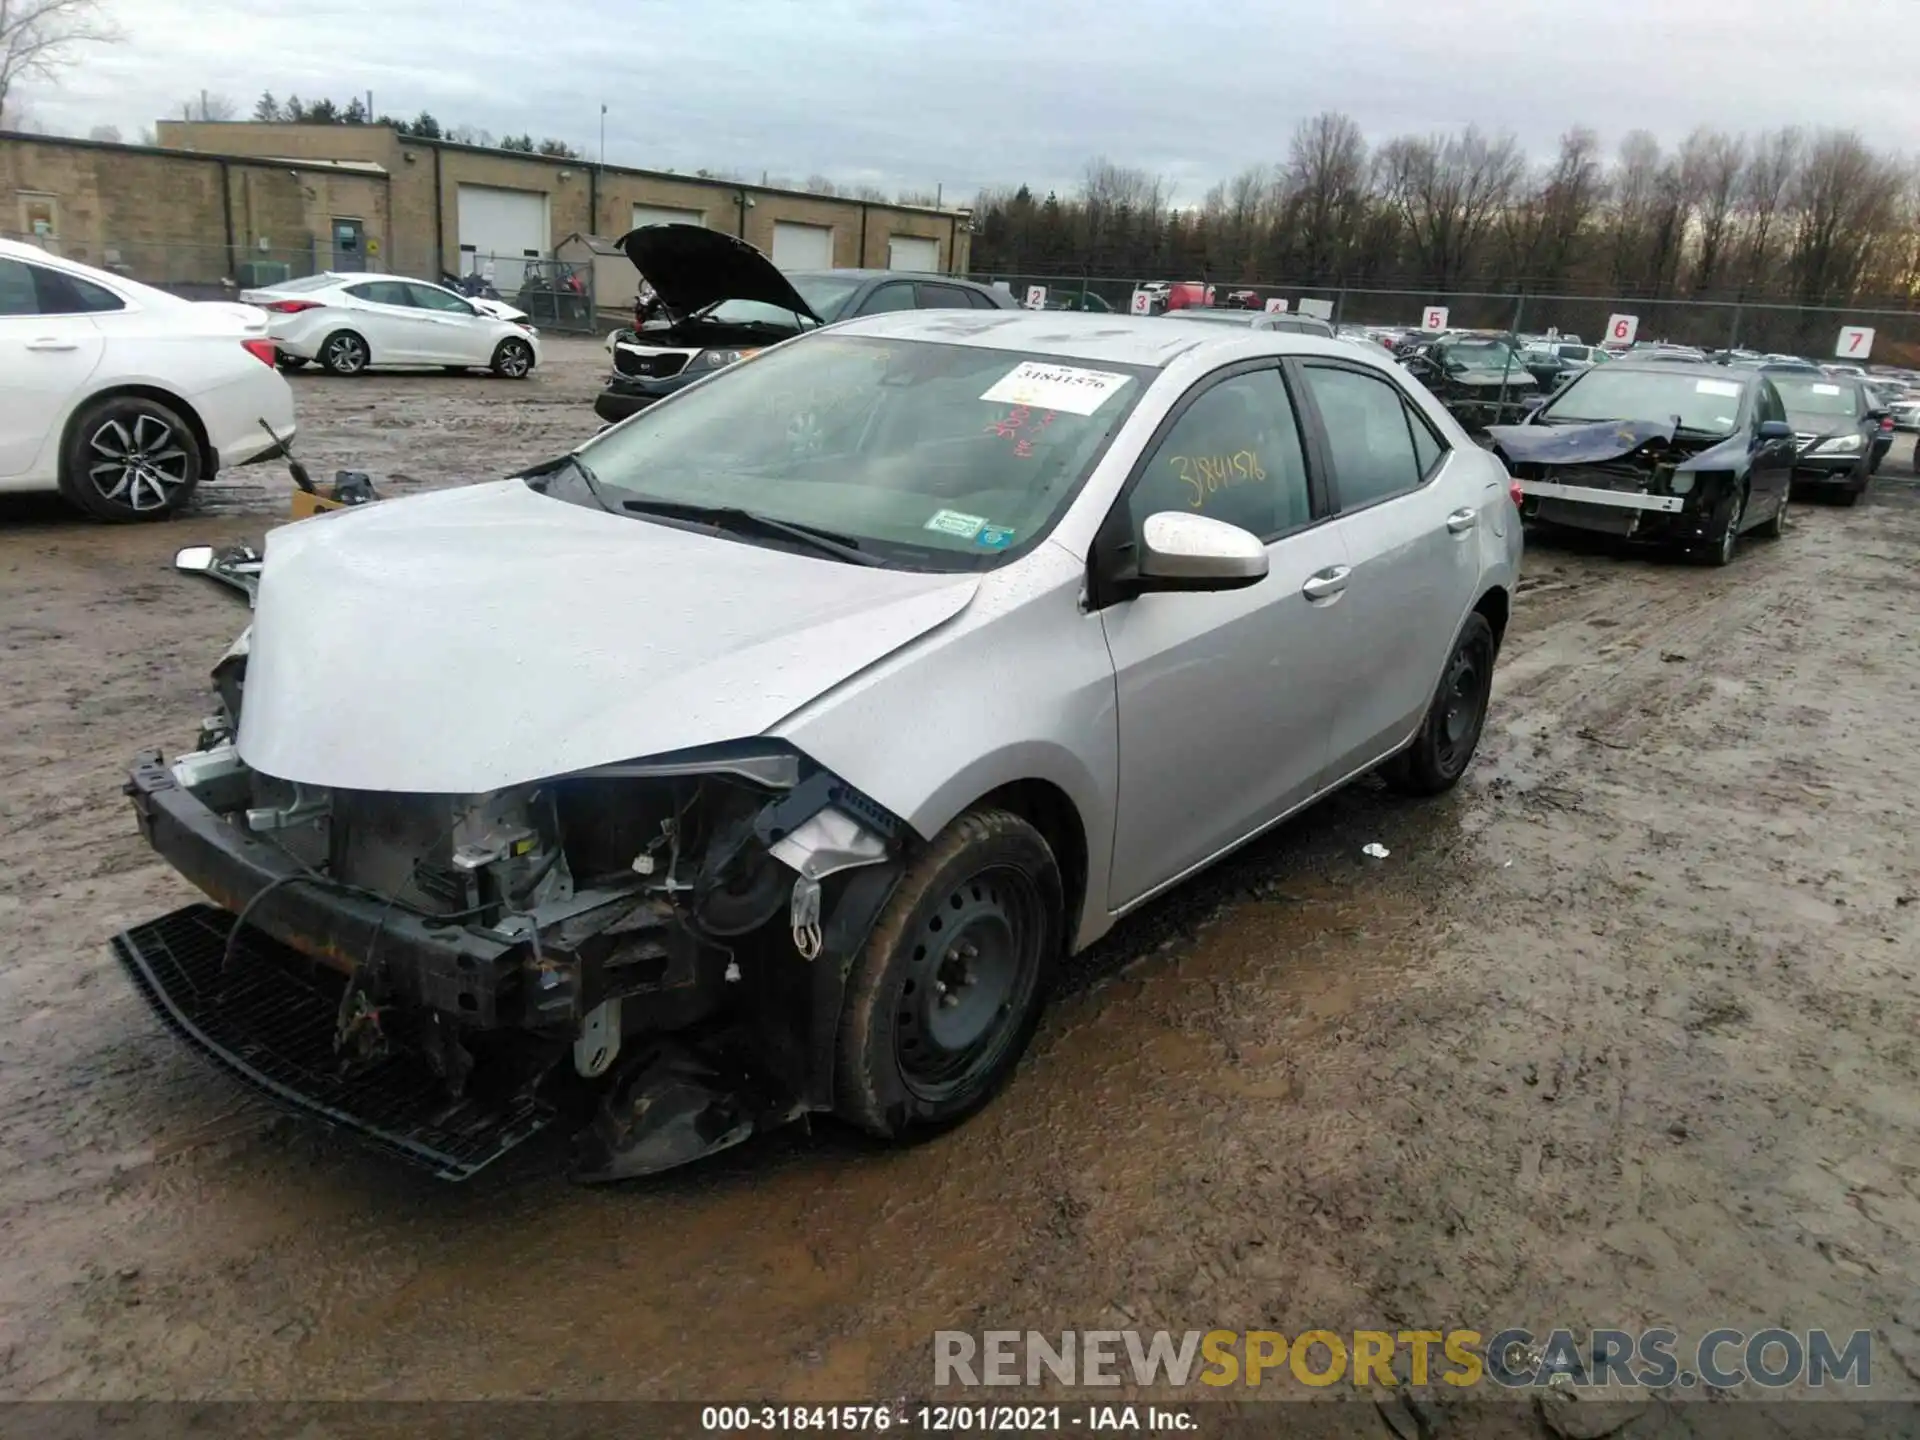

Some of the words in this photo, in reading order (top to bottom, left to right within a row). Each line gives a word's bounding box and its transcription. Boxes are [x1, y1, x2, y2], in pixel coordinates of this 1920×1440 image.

[1031, 289, 1041, 305] 2
[1136, 295, 1146, 310] 3
[1428, 311, 1440, 329] 5
[1614, 319, 1629, 338] 6
[1848, 332, 1864, 352] 7
